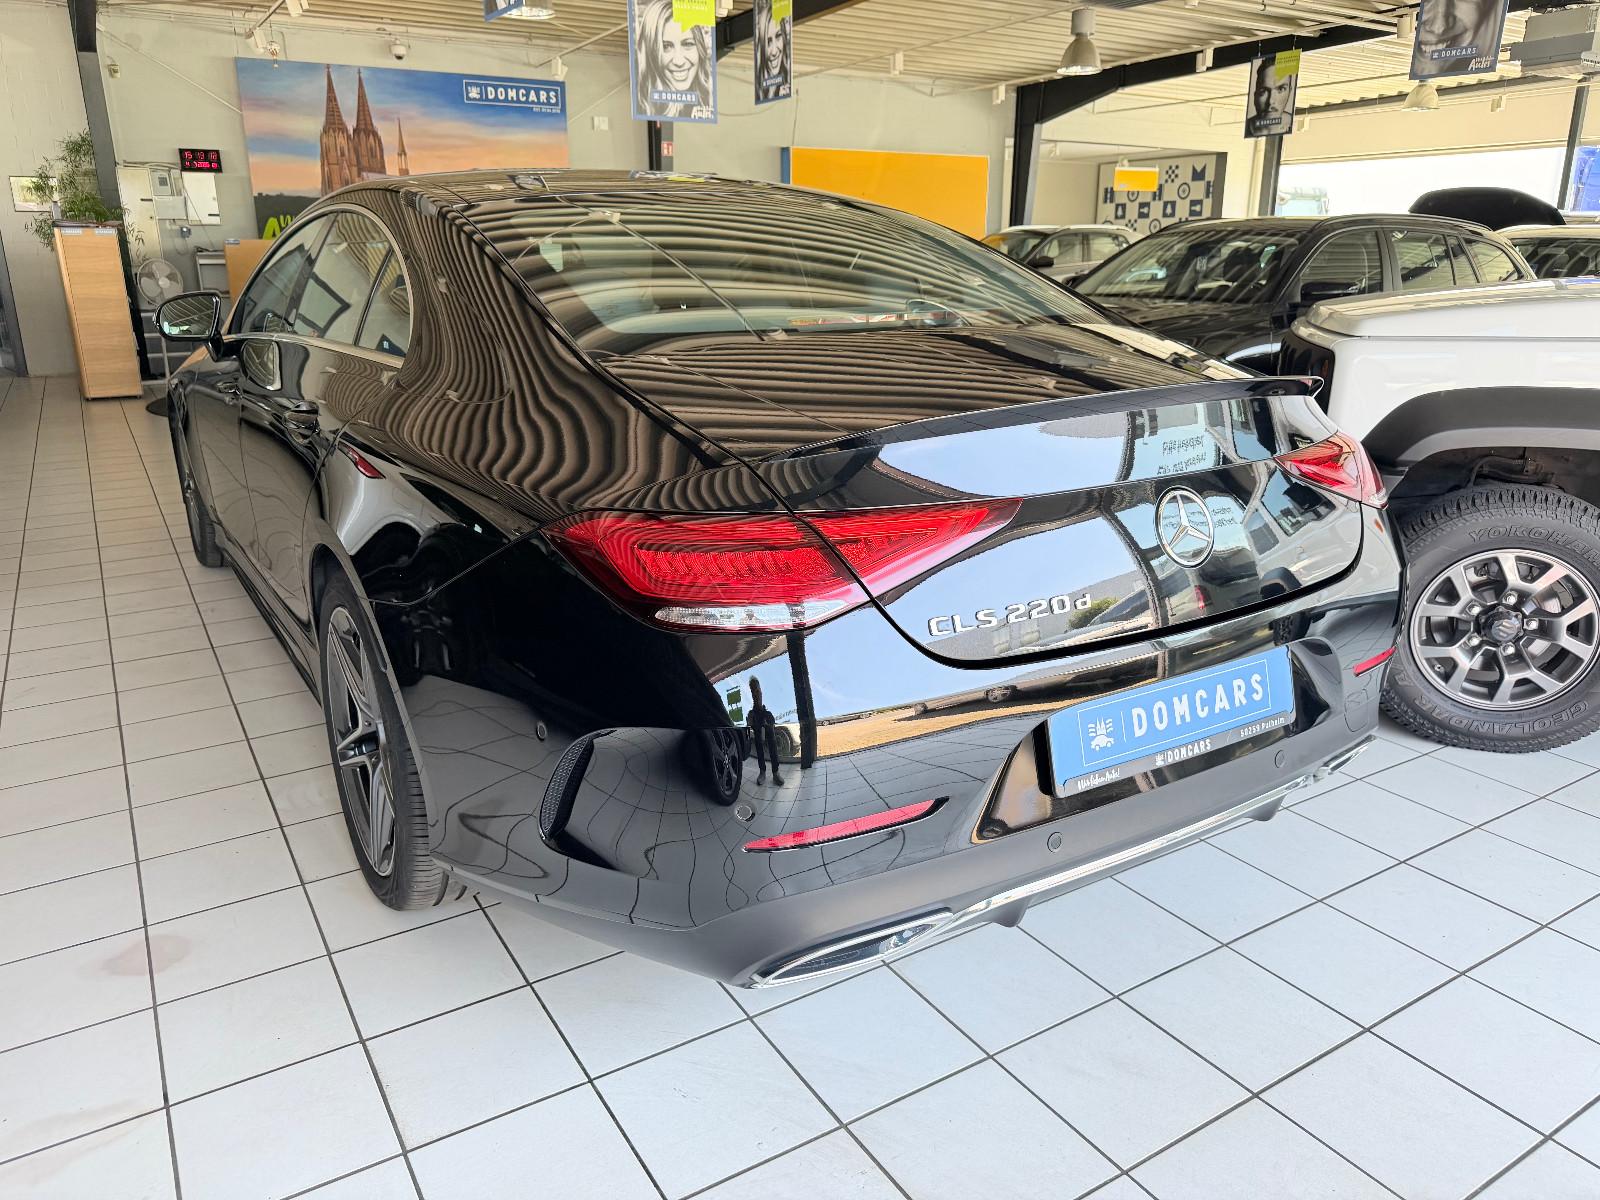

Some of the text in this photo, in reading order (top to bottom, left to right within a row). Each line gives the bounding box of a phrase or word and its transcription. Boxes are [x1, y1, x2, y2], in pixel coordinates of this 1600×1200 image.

[1441, 47, 1477, 58] DOMCARS
[487, 86, 557, 103] DOMCARS
[661, 92, 696, 102] DOMCARS
[928, 609, 998, 636] CLS
[1131, 673, 1264, 737] DOMCARS
[1414, 695, 1588, 735] GEOLANDAR
[1240, 724, 1260, 738] 50259
[1167, 738, 1211, 763] DOMCARS
